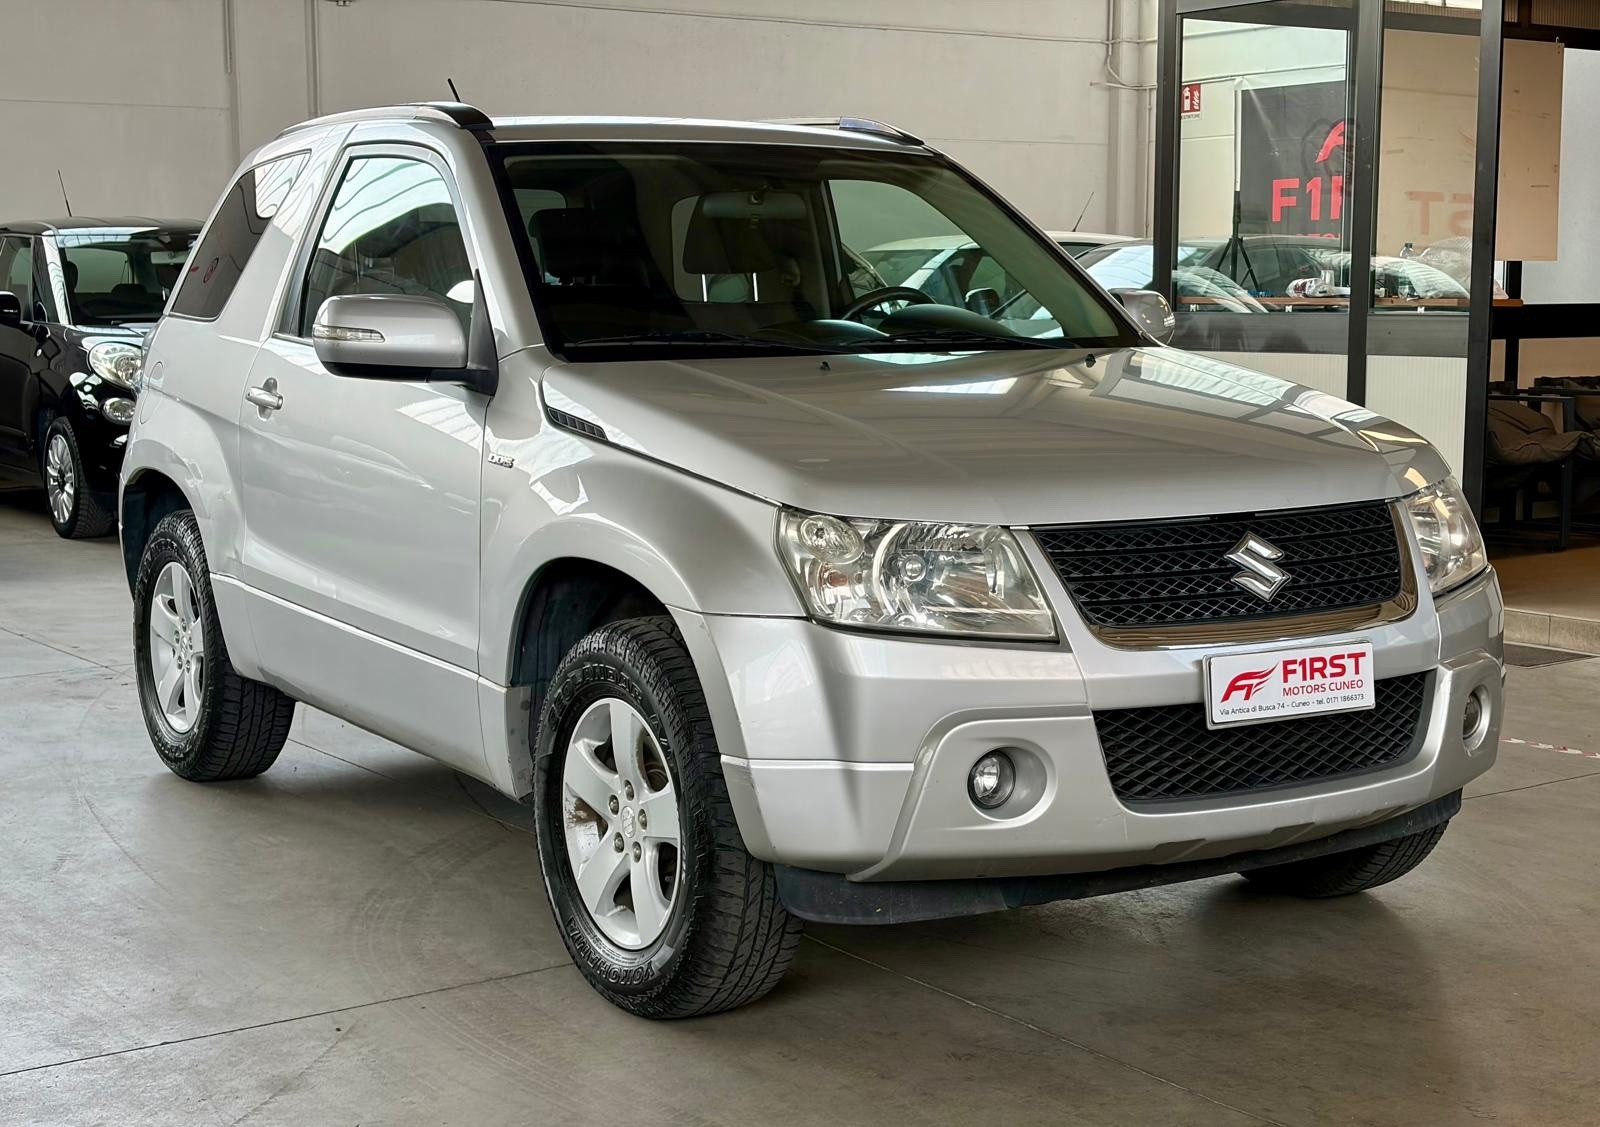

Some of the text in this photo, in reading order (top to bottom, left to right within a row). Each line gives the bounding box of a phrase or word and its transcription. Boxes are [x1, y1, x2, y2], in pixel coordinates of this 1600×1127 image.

[1282, 651, 1367, 683] F1RST
[1282, 679, 1364, 697] MOTORS CUNEO
[1219, 708, 1229, 716] Via
[1230, 706, 1250, 715] Antica
[1258, 704, 1276, 712] Busca
[1291, 700, 1310, 708] Cuneo
[1326, 696, 1339, 704] 0171
[566, 915, 656, 985] YOKOHAMA
